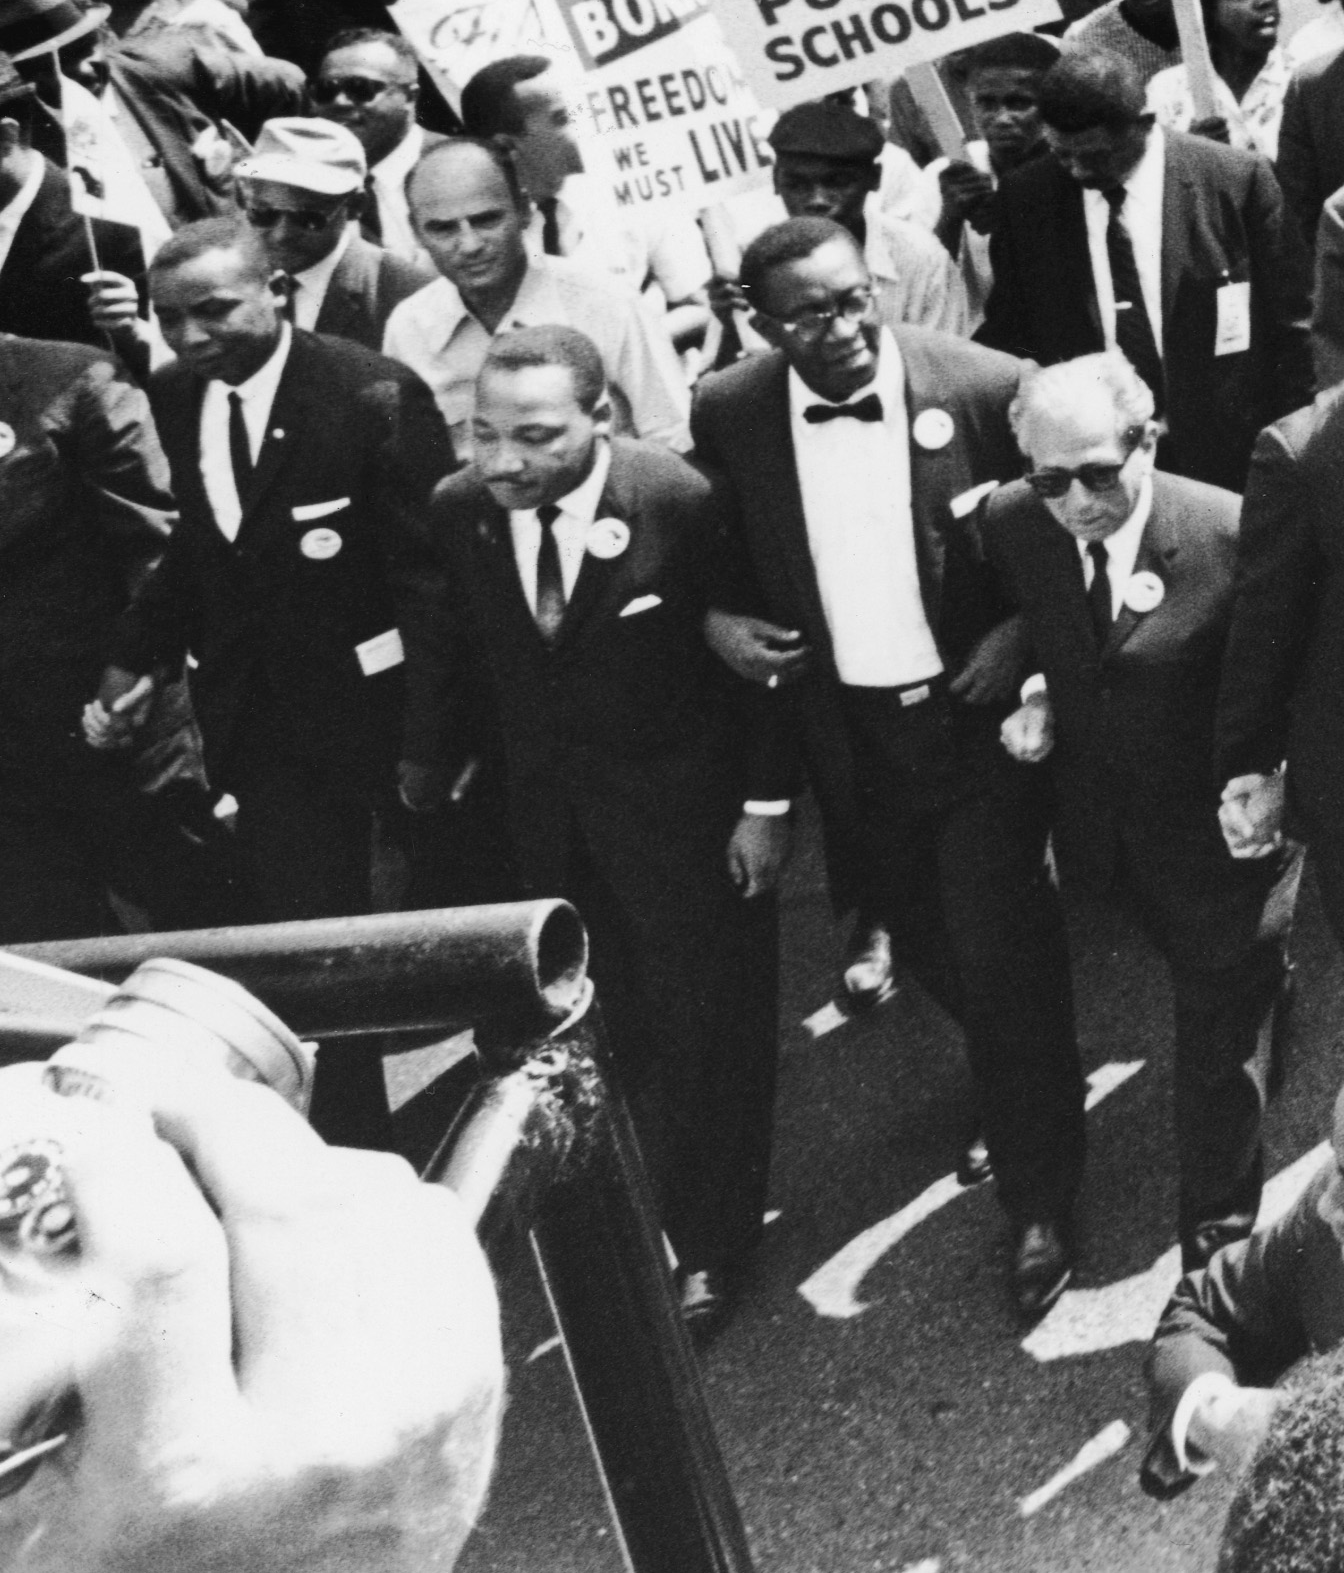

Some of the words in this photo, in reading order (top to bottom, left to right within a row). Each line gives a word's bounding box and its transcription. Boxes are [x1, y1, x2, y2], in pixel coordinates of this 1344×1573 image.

[586, 64, 746, 135] FREEDO
[613, 142, 650, 171] WE
[688, 115, 773, 185] LIVE
[613, 165, 685, 207] MUST
